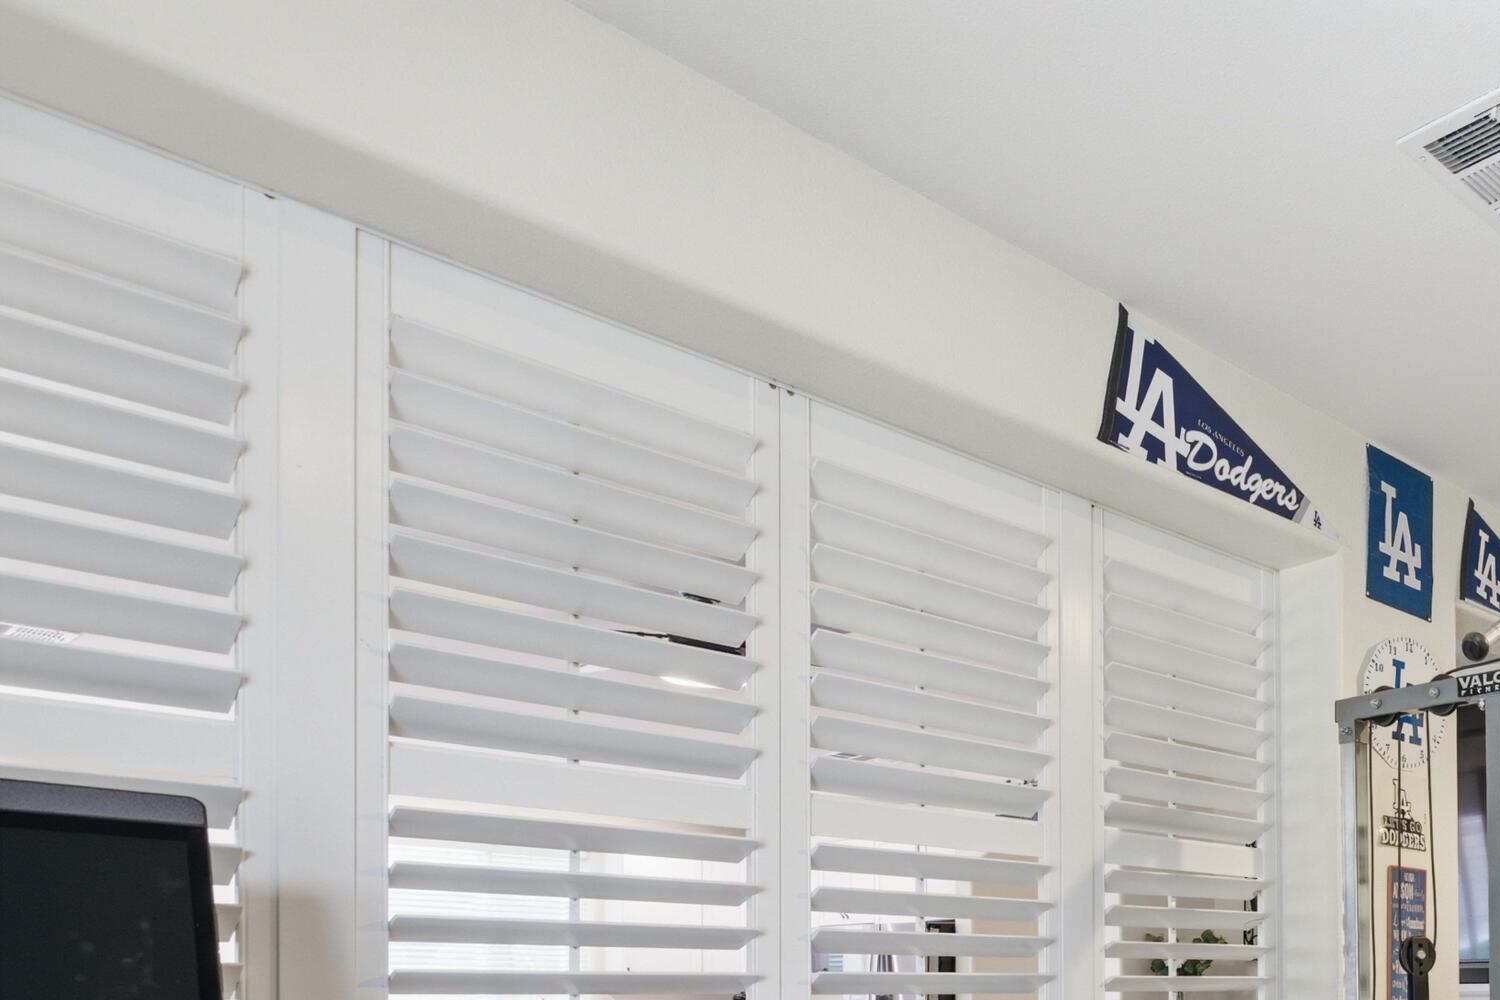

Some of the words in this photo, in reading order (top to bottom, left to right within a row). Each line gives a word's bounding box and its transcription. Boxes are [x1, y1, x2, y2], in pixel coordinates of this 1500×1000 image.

[1115, 316, 1191, 471] LA
[1198, 419, 1212, 433] LOS
[1212, 431, 1245, 457] ANGELES
[1184, 429, 1300, 511] Dodgers
[1378, 480, 1421, 591] LA
[1392, 778, 1412, 819] LA
[1381, 829, 1425, 850] DODGERS
[1409, 819, 1422, 834] GO
